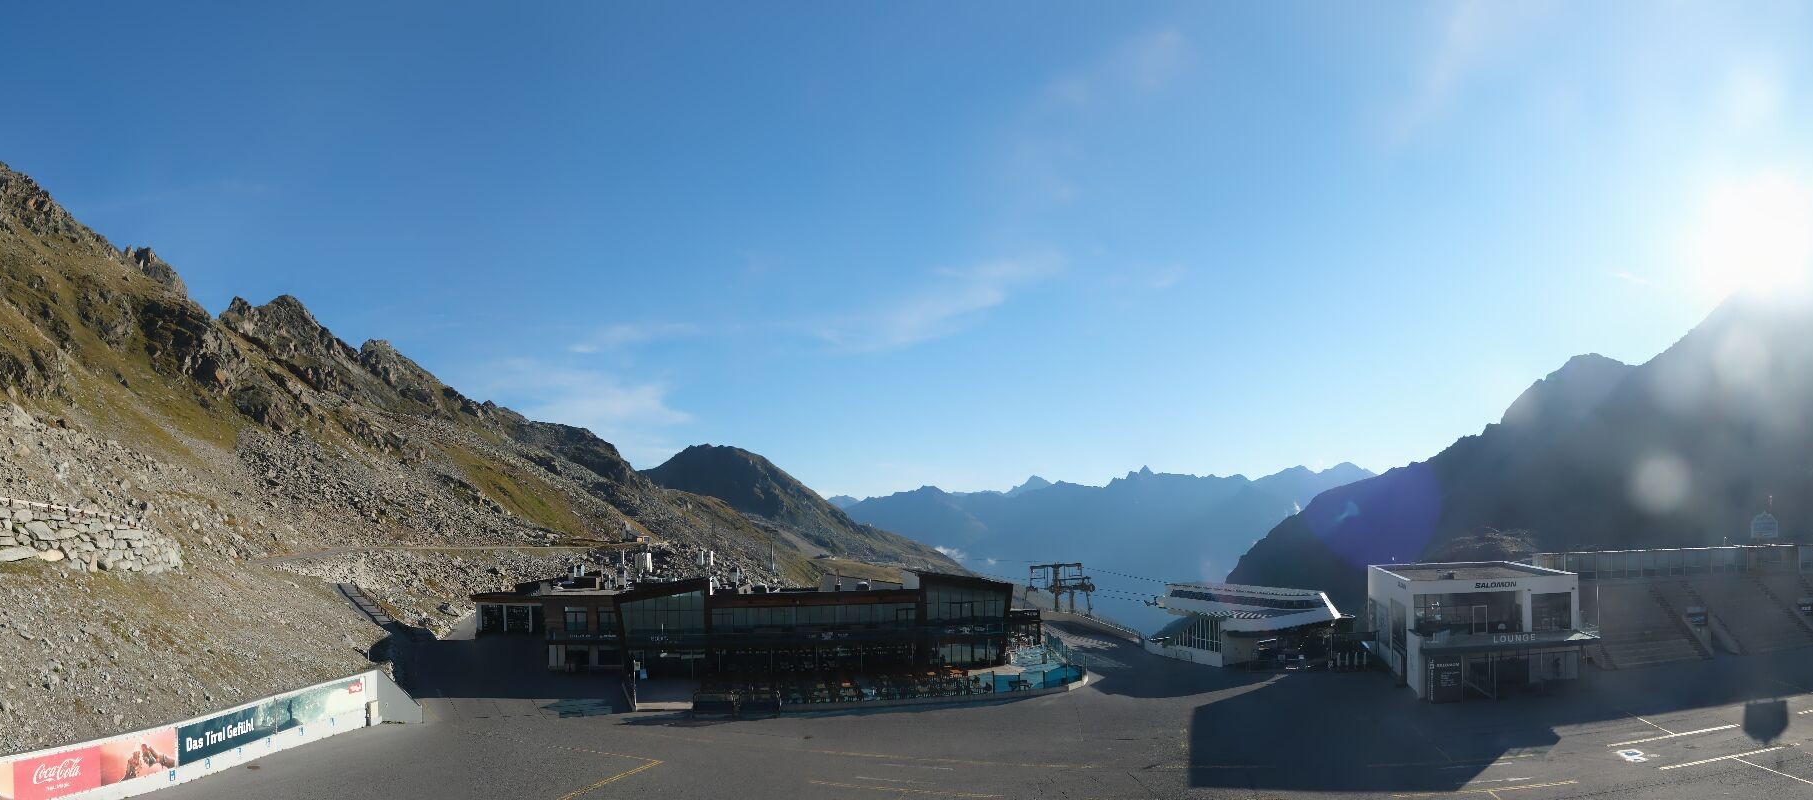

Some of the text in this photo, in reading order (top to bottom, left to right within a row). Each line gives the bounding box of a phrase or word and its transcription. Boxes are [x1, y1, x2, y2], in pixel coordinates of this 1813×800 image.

[1474, 581, 1517, 589] SALOMON
[1493, 633, 1536, 644] LOUNGE
[186, 718, 255, 752] Das Tirol Gefühl
[32, 757, 82, 785] Coca-Cola
